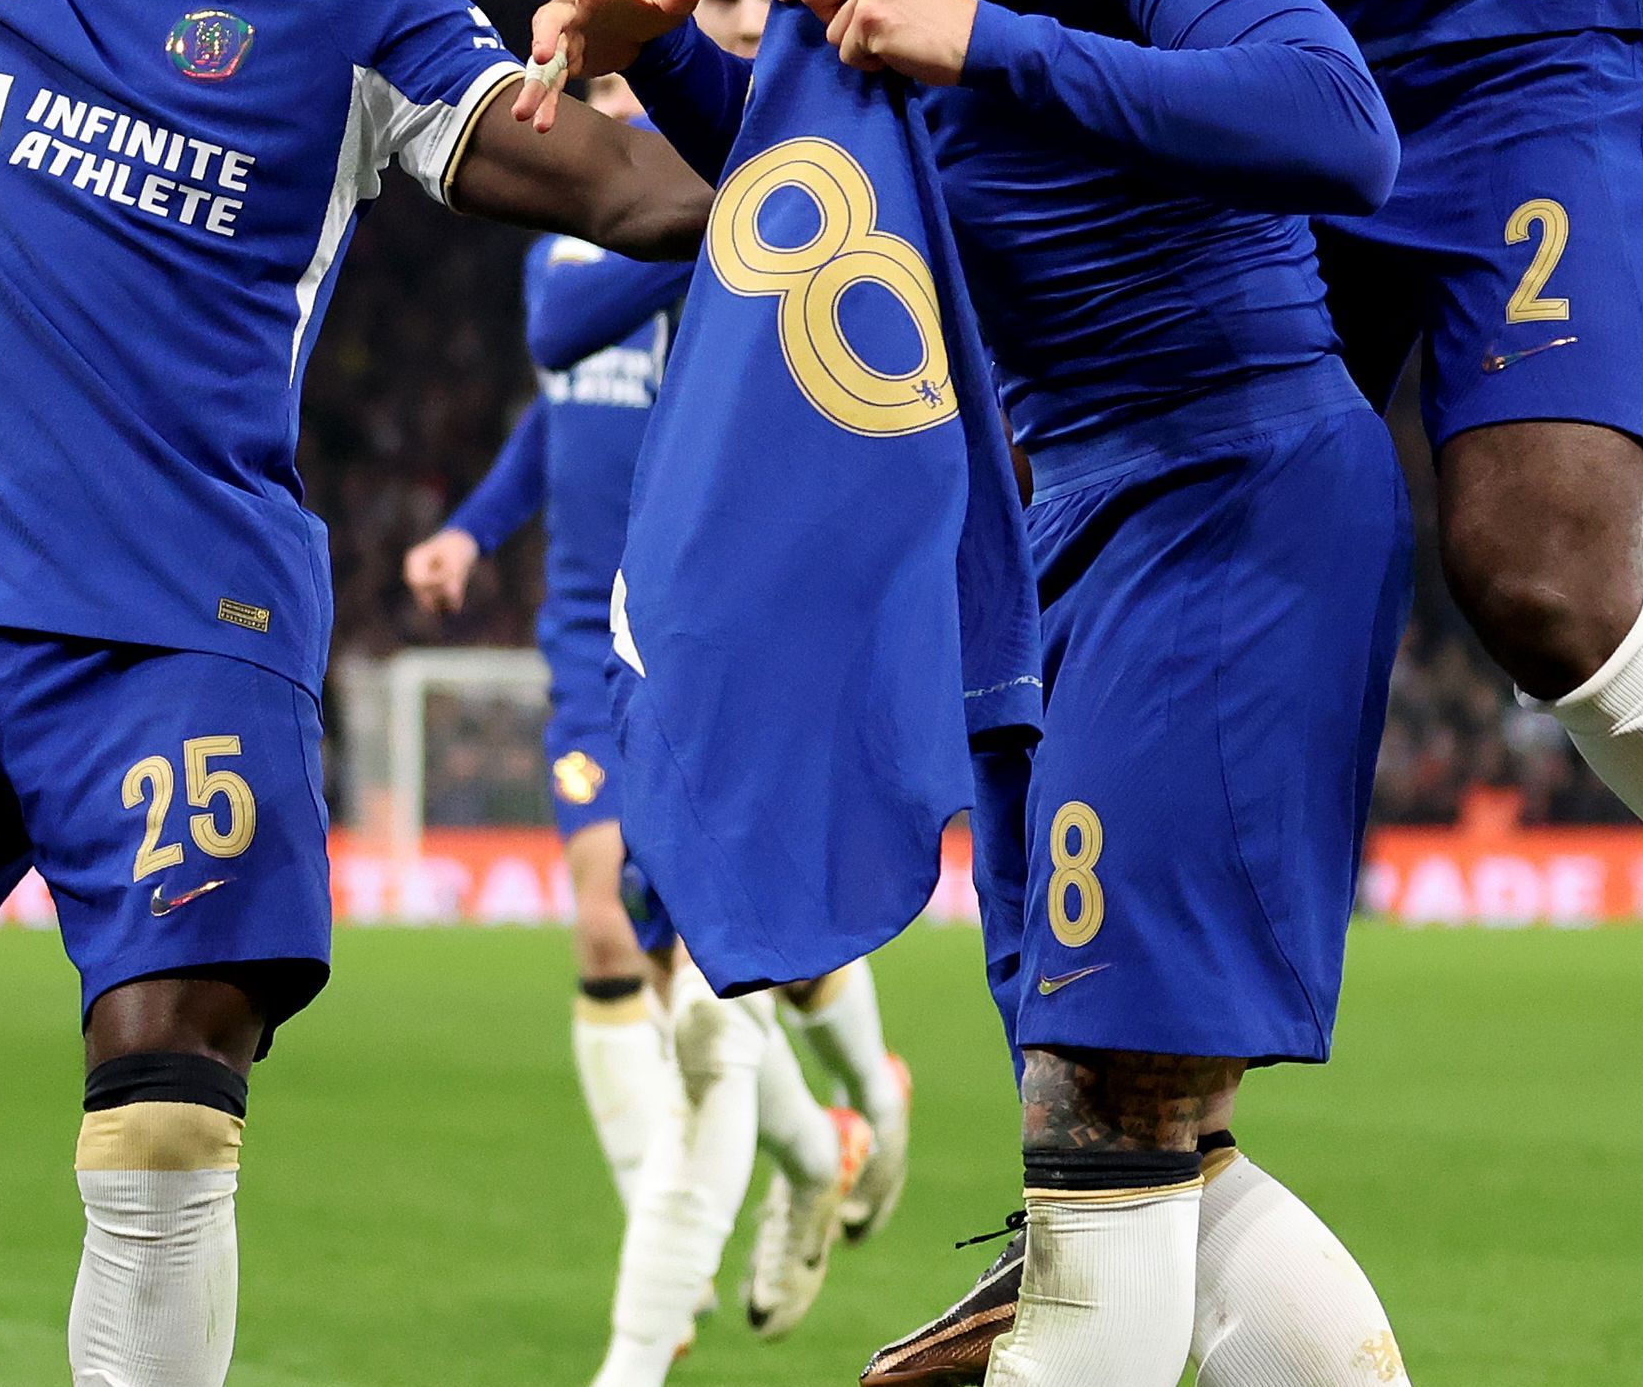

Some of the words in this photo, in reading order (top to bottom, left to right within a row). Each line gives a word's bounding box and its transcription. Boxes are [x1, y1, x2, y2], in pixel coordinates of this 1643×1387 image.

[8, 130, 244, 237] ATHLETE
[25, 87, 256, 192] INFINITE
[707, 135, 959, 438] 8
[1504, 198, 1570, 325] 2
[121, 735, 256, 883] 25
[1047, 800, 1104, 948] 8
